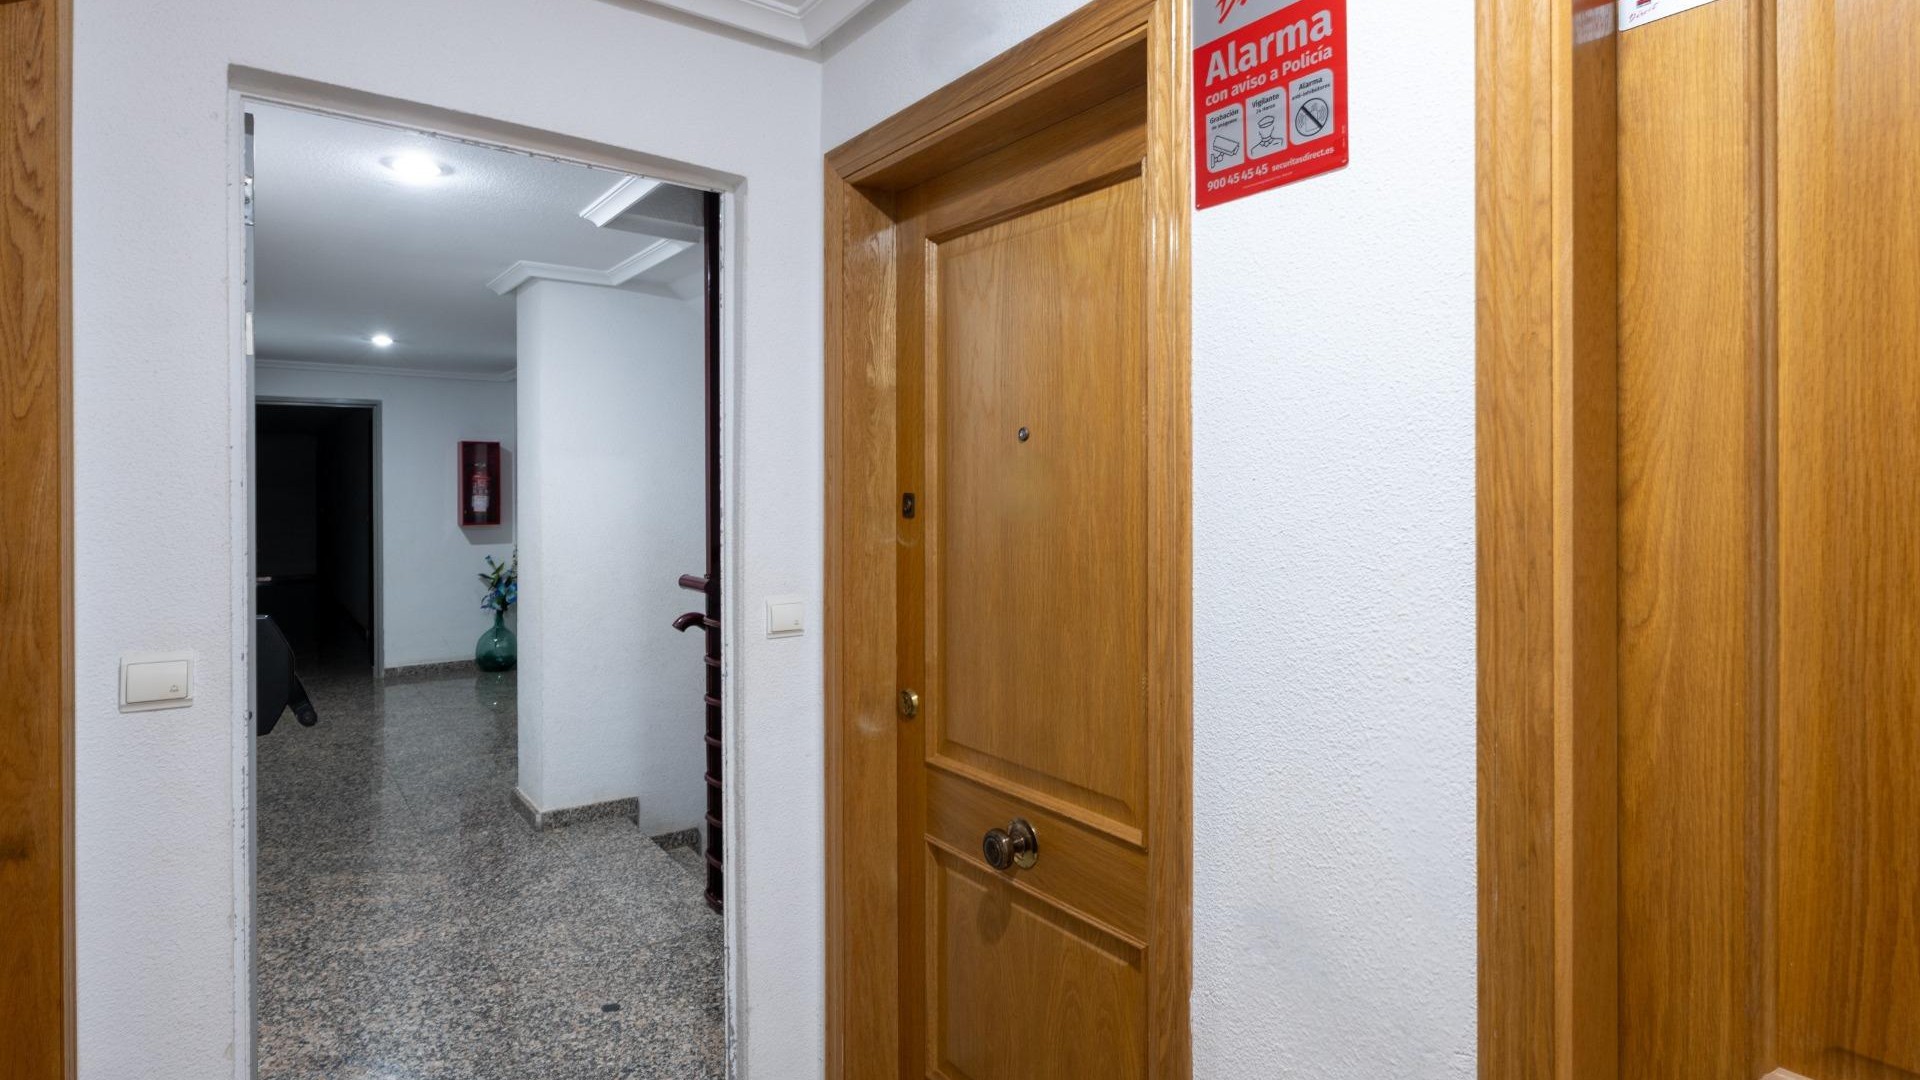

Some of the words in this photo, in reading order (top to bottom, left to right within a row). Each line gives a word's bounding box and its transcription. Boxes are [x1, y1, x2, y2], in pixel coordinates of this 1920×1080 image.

[1205, 9, 1333, 87] Alarma
[1205, 89, 1228, 106] con
[1231, 73, 1266, 96] aviso
[1269, 68, 1279, 81] a
[1282, 45, 1333, 76] Policía
[1298, 77, 1323, 91] Alarma
[1209, 108, 1239, 125] Grabación
[1251, 93, 1280, 109] Vigilante
[1207, 176, 1226, 192] 900
[1227, 172, 1240, 185] 45
[1241, 168, 1254, 181] 45
[1255, 163, 1269, 177] 45
[1271, 146, 1335, 172] securitasdirect.es
